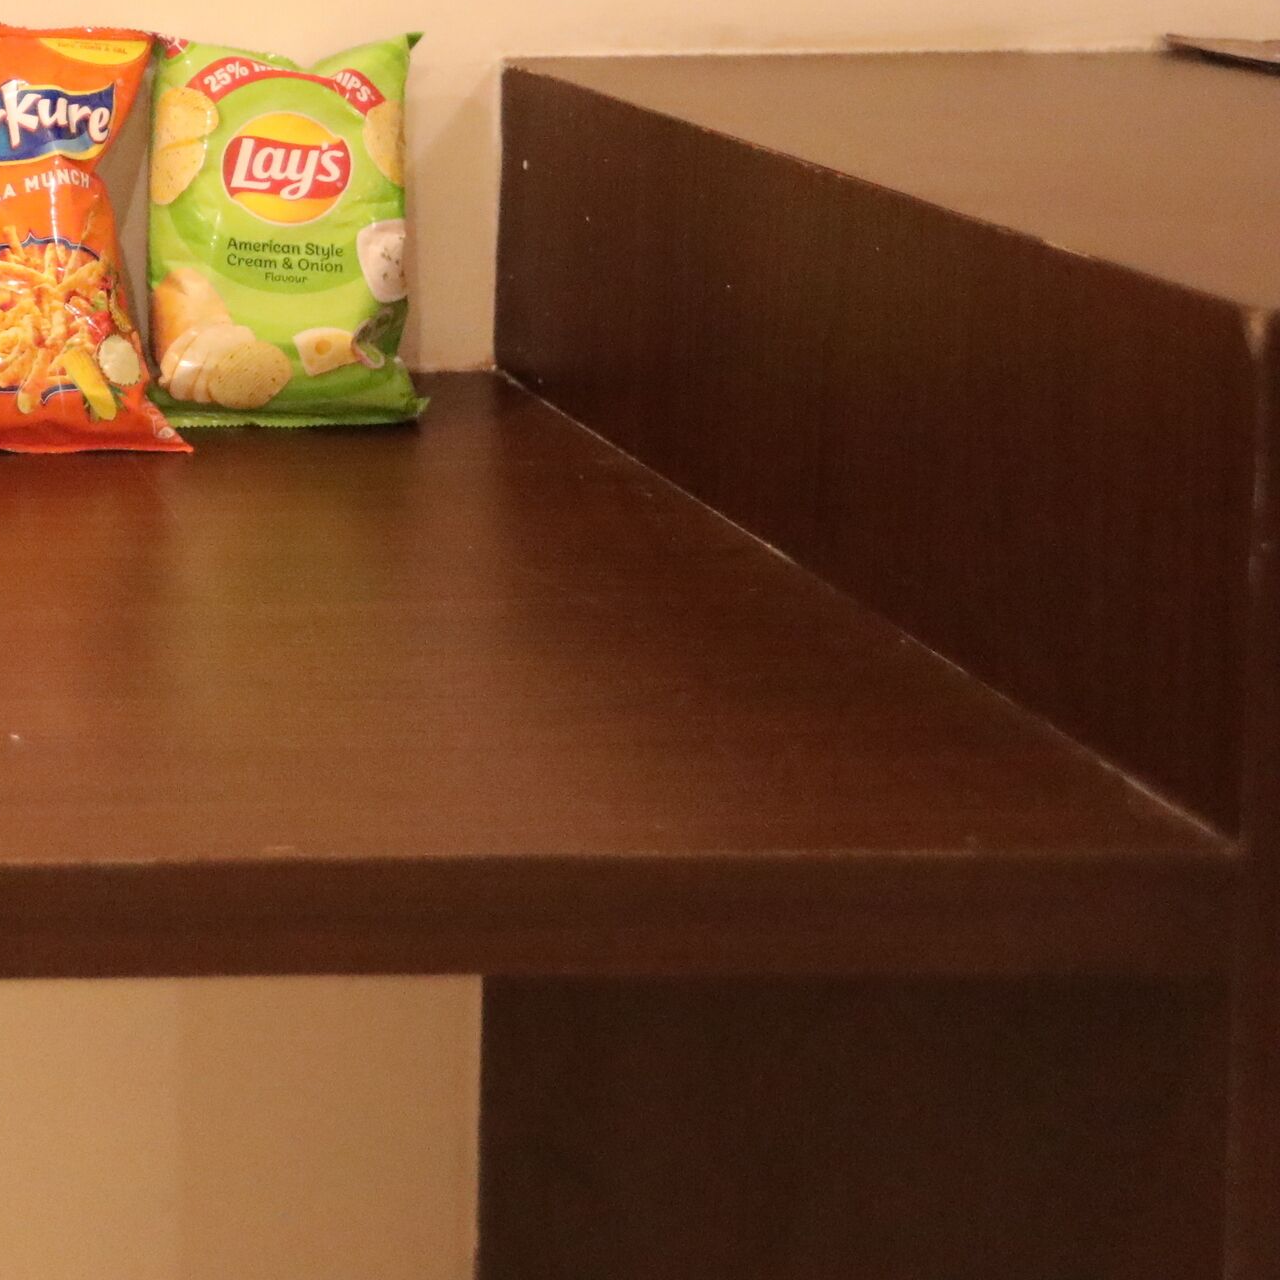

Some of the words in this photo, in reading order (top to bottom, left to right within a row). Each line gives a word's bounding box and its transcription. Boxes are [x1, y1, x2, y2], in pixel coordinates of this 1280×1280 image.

[203, 60, 250, 93] 25%
[23, 167, 91, 194] MUNCH
[229, 137, 345, 201] Lay's
[226, 236, 301, 256] American
[305, 242, 344, 261] Style
[226, 254, 278, 269] Cream
[282, 256, 294, 271] &
[297, 257, 344, 273] Onion
[264, 271, 308, 284] Flavour
